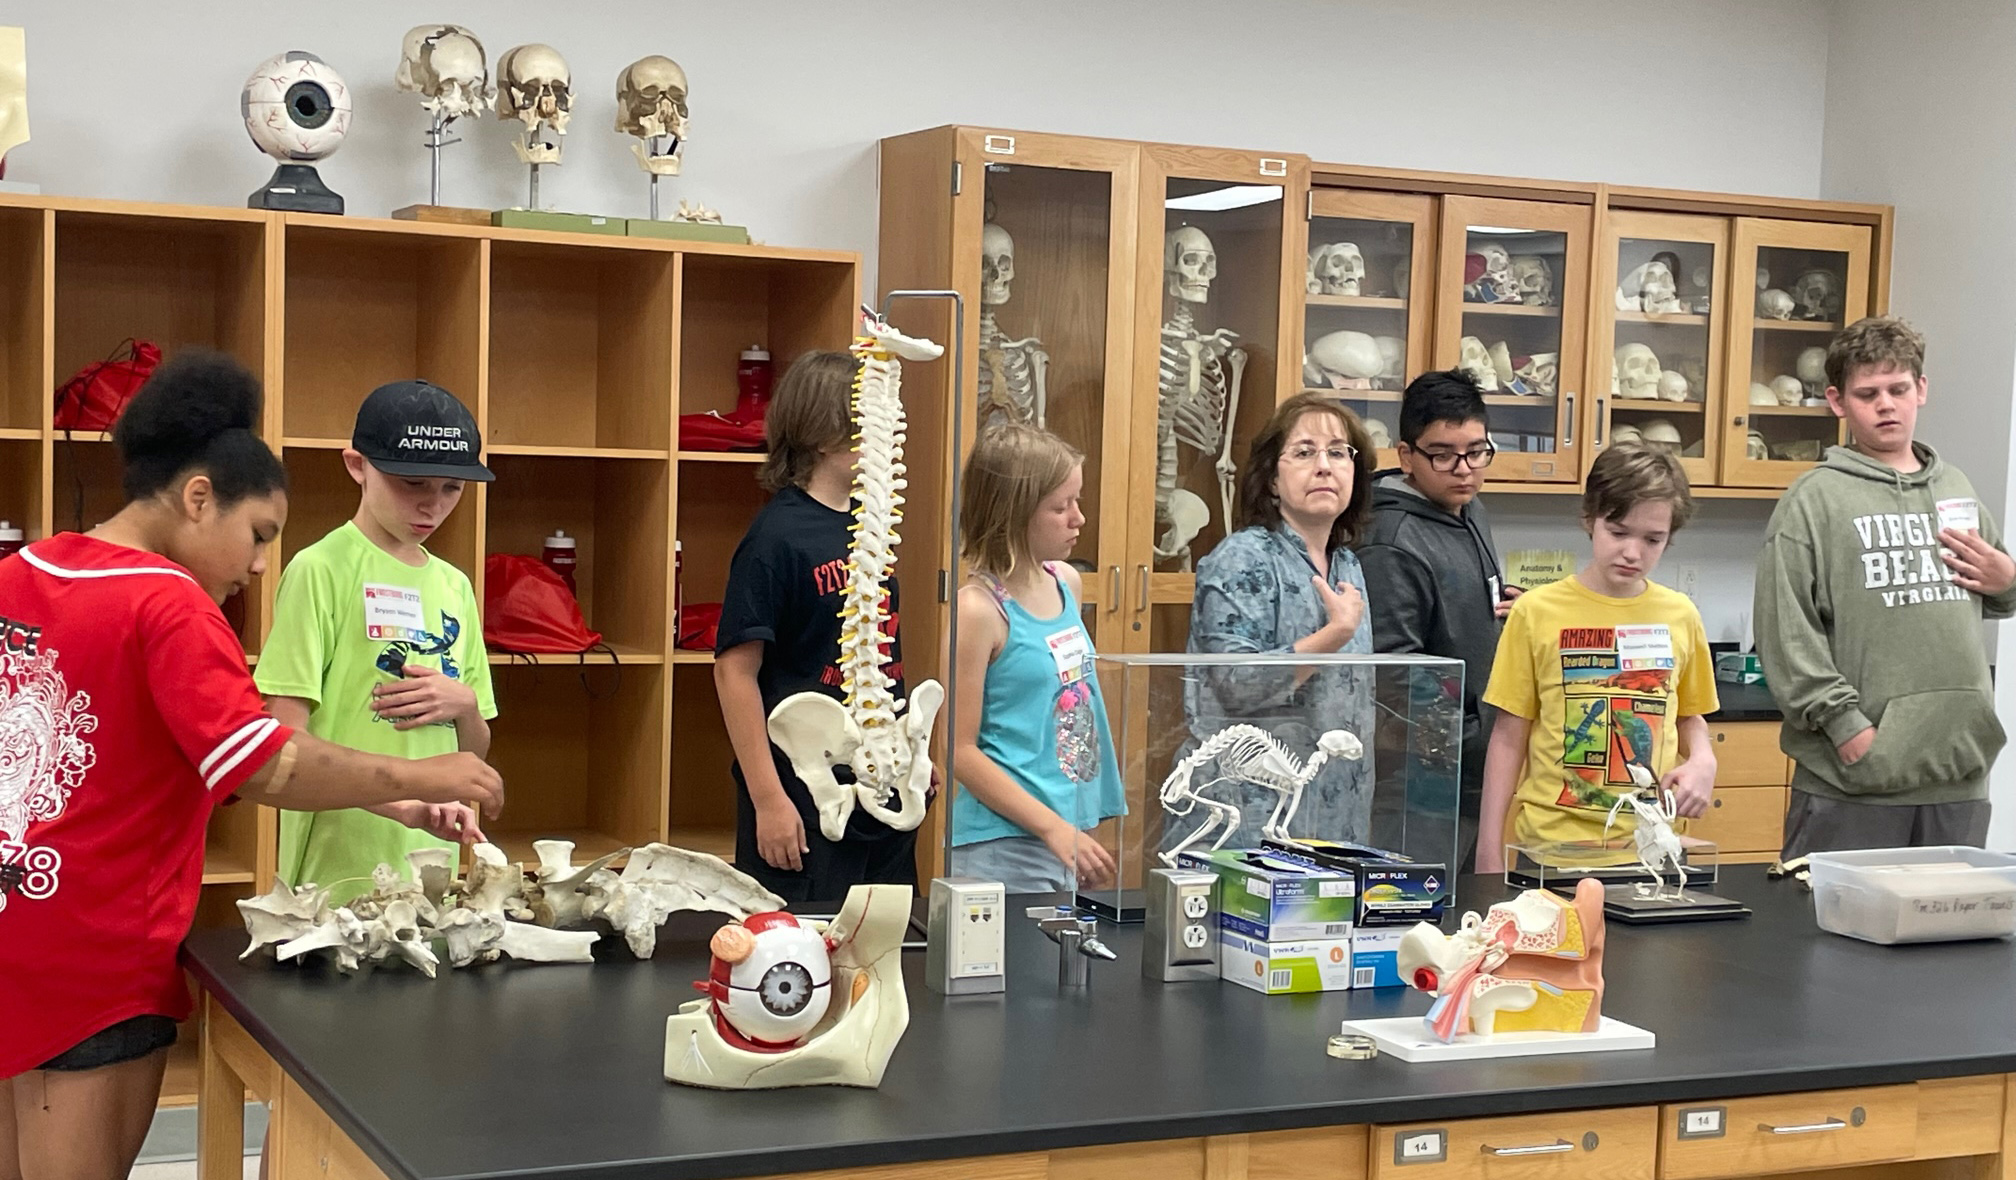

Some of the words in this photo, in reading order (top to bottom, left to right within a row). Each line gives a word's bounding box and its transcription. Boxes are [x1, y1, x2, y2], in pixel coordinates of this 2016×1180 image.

[407, 425, 461, 438] UNDER
[398, 438, 469, 452] ARMOUR
[1853, 512, 1936, 550] VIRGI
[1520, 564, 1555, 573] Anatomy
[1556, 564, 1563, 572] &
[1861, 548, 1959, 589] BEAC
[1882, 585, 1971, 608] VIRGINIA
[1561, 629, 1613, 648] AMAZING
[1563, 655, 1591, 667] Bearded
[1592, 656, 1616, 669] Dragon
[1697, 1116, 1710, 1126] 14
[1414, 1142, 1428, 1153] 14
